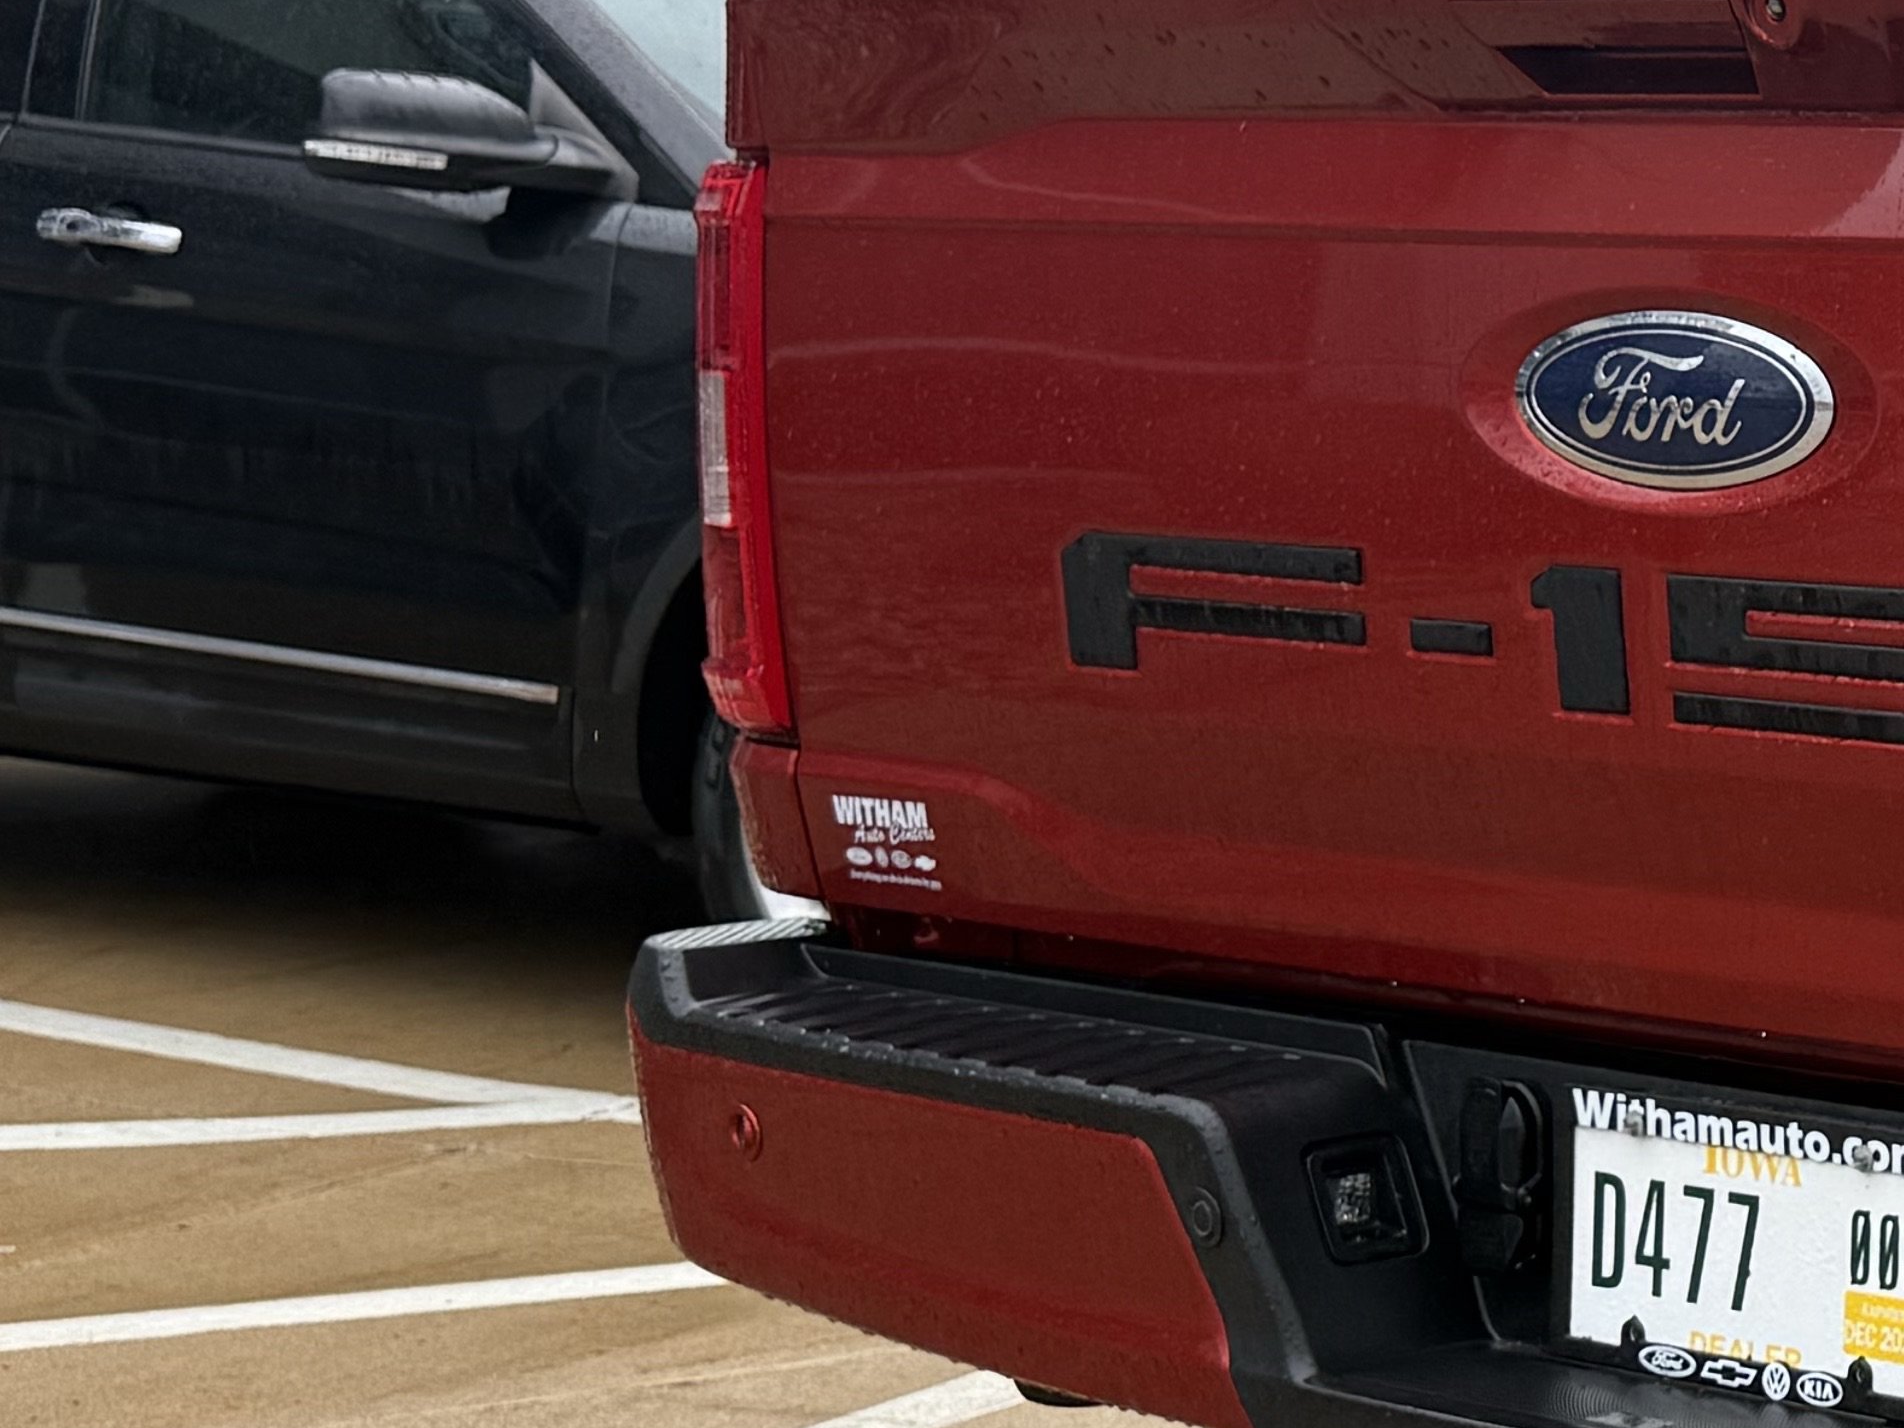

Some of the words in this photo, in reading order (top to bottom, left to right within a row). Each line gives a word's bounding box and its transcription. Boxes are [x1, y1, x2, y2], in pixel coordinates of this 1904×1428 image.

[1578, 346, 1746, 447] Ford
[831, 794, 928, 829] WITHAM
[1702, 1143, 1803, 1187] IOWA
[1590, 1170, 1760, 1312] D477
[1844, 1319, 1878, 1350] DEC
[1803, 1379, 1834, 1400] KIA
